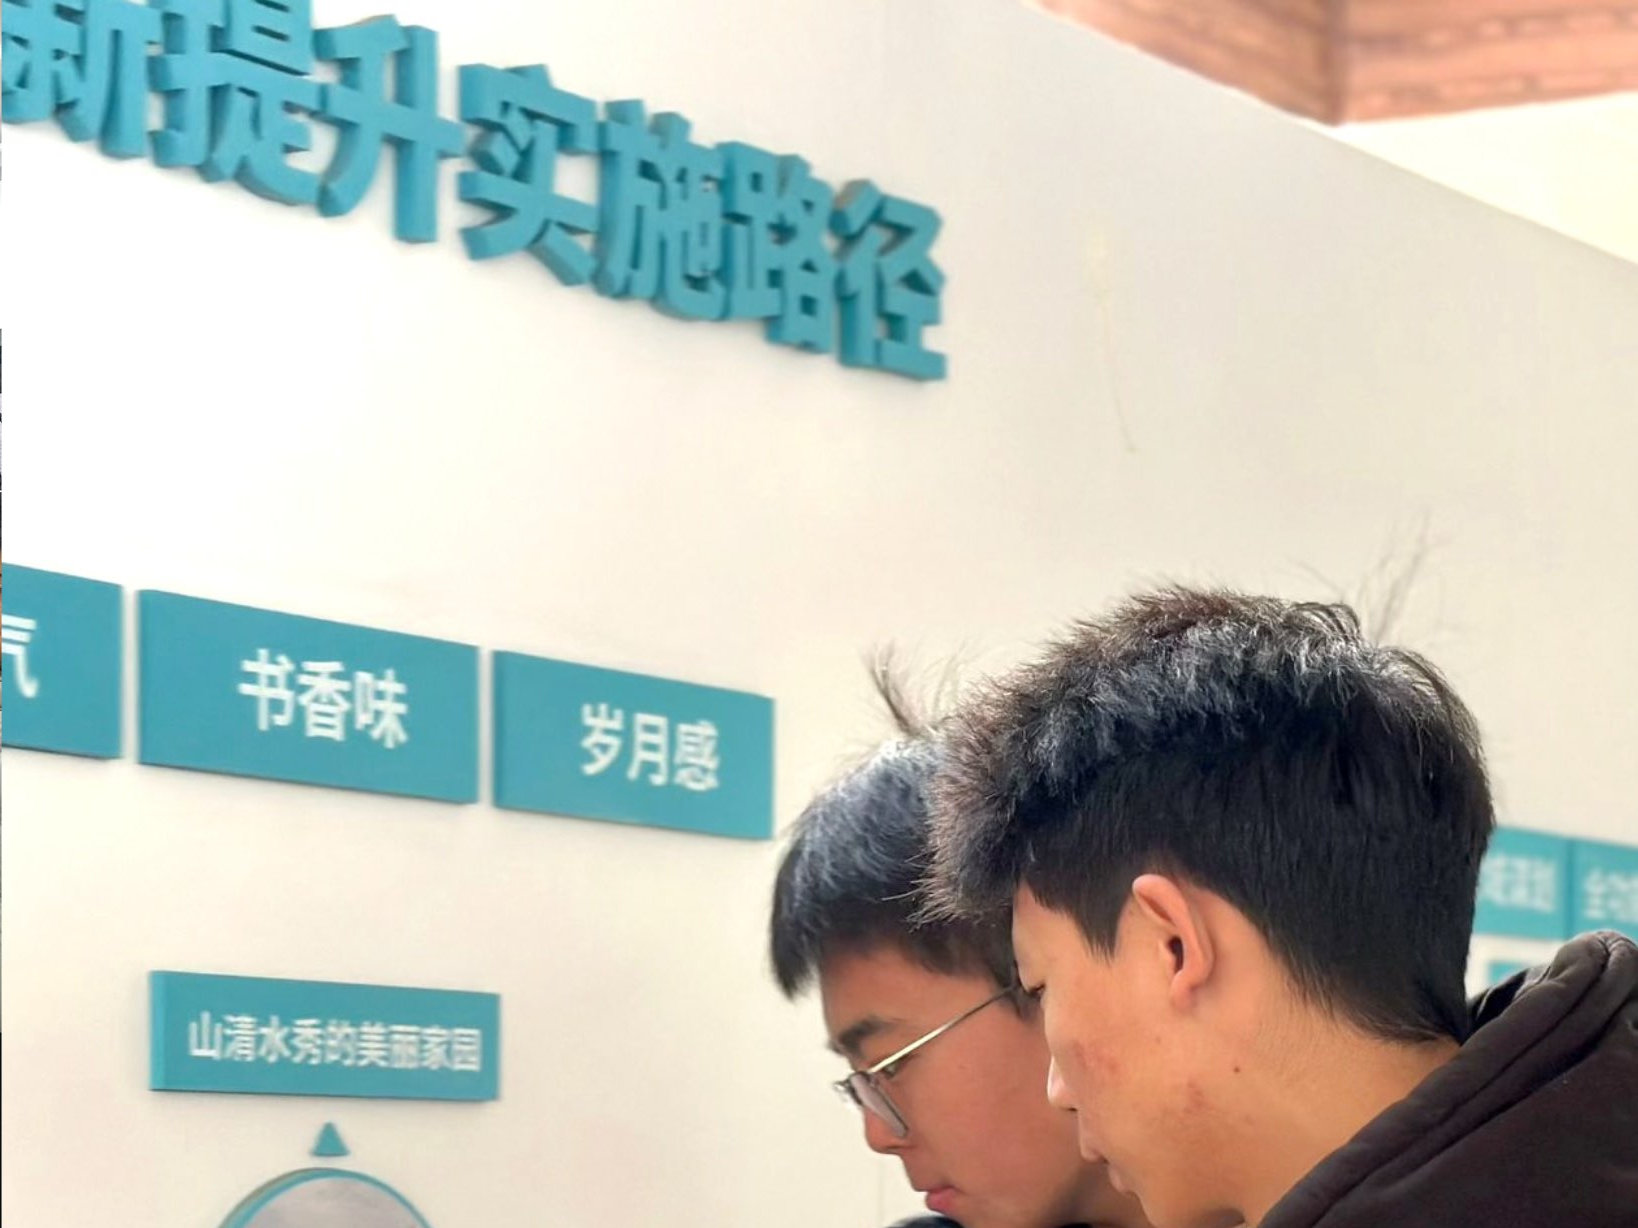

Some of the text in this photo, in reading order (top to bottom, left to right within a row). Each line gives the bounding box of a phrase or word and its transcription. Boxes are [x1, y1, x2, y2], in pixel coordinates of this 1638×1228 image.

[238, 647, 409, 750] 书香味
[579, 702, 721, 792] 岁月感
[188, 1010, 481, 1072] 山清水秀的美丽家园
